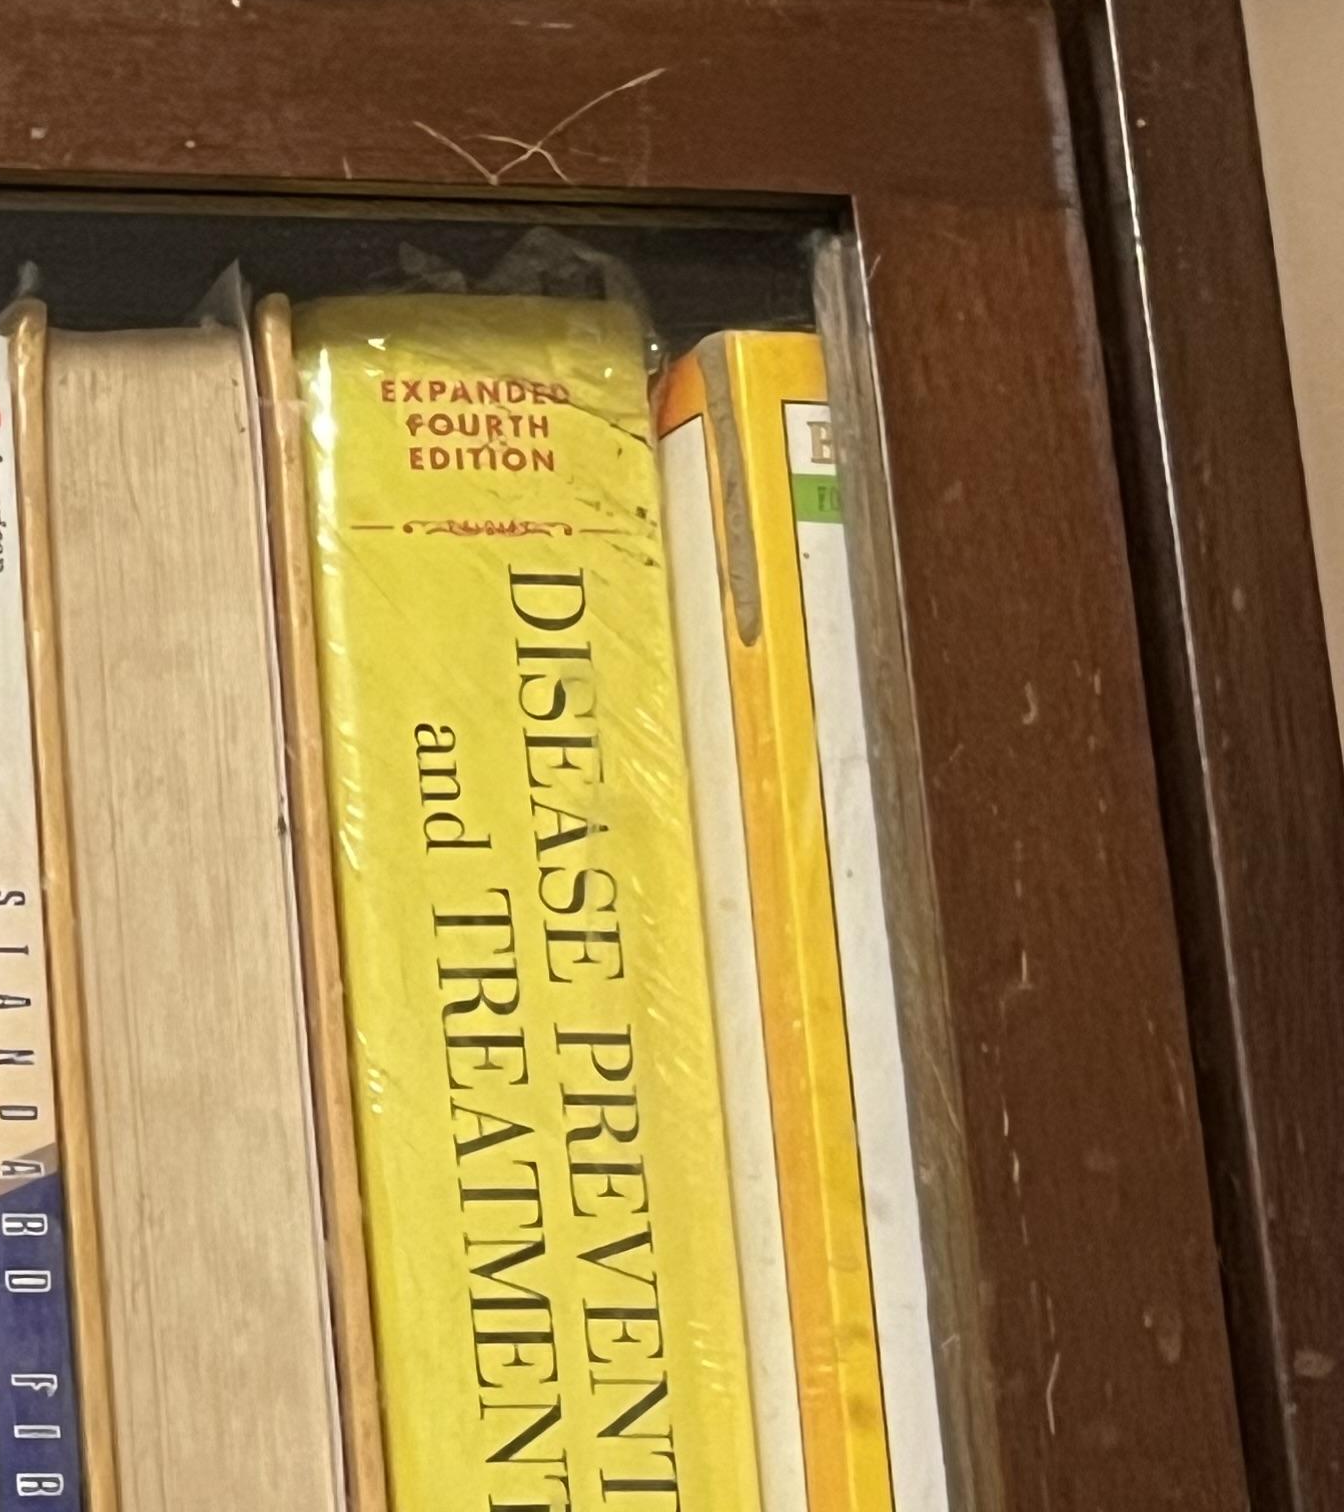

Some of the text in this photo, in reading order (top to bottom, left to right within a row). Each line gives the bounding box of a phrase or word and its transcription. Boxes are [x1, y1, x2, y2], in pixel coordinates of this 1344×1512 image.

[380, 378, 571, 406] EXPANDED
[406, 413, 551, 439] FOURTH
[408, 446, 556, 473] EDITION
[506, 563, 626, 984] DISEASE
[413, 721, 493, 857] and
